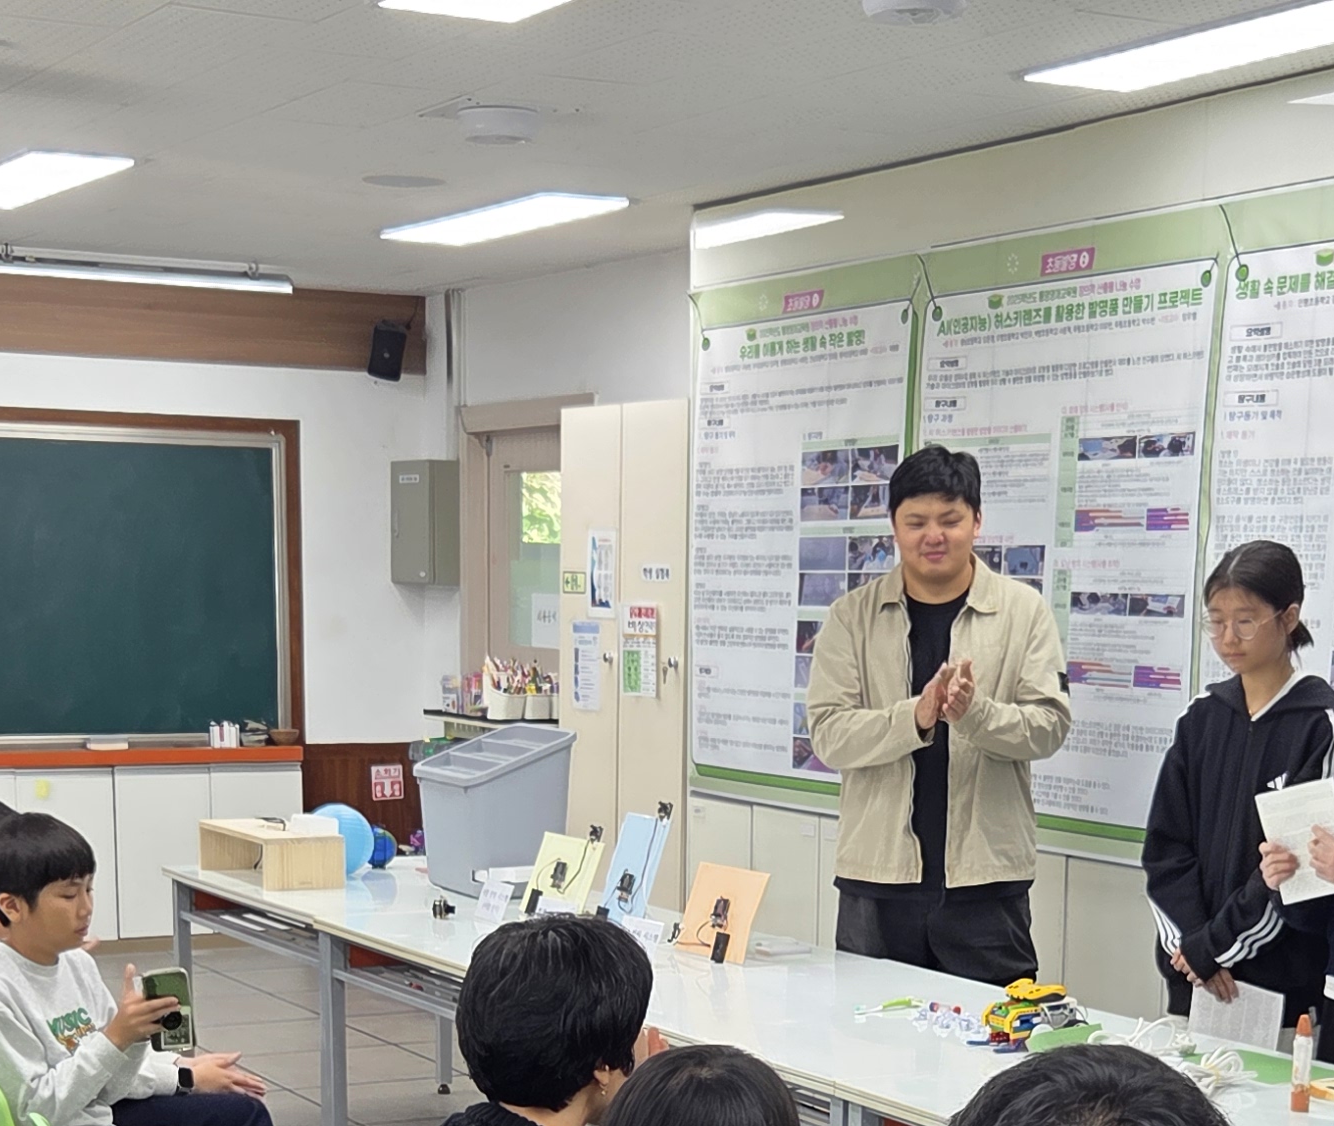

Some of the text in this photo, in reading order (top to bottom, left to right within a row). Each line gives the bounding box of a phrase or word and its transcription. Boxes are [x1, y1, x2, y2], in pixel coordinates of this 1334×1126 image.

[1235, 279, 1260, 300] 생활
[1264, 279, 1274, 297] 속
[1277, 272, 1311, 296] 문제를
[1055, 305, 1085, 323] 활용한
[1088, 300, 1119, 320] 발명품
[1122, 294, 1154, 316] 만들기
[1157, 287, 1204, 310] 프로젝트
